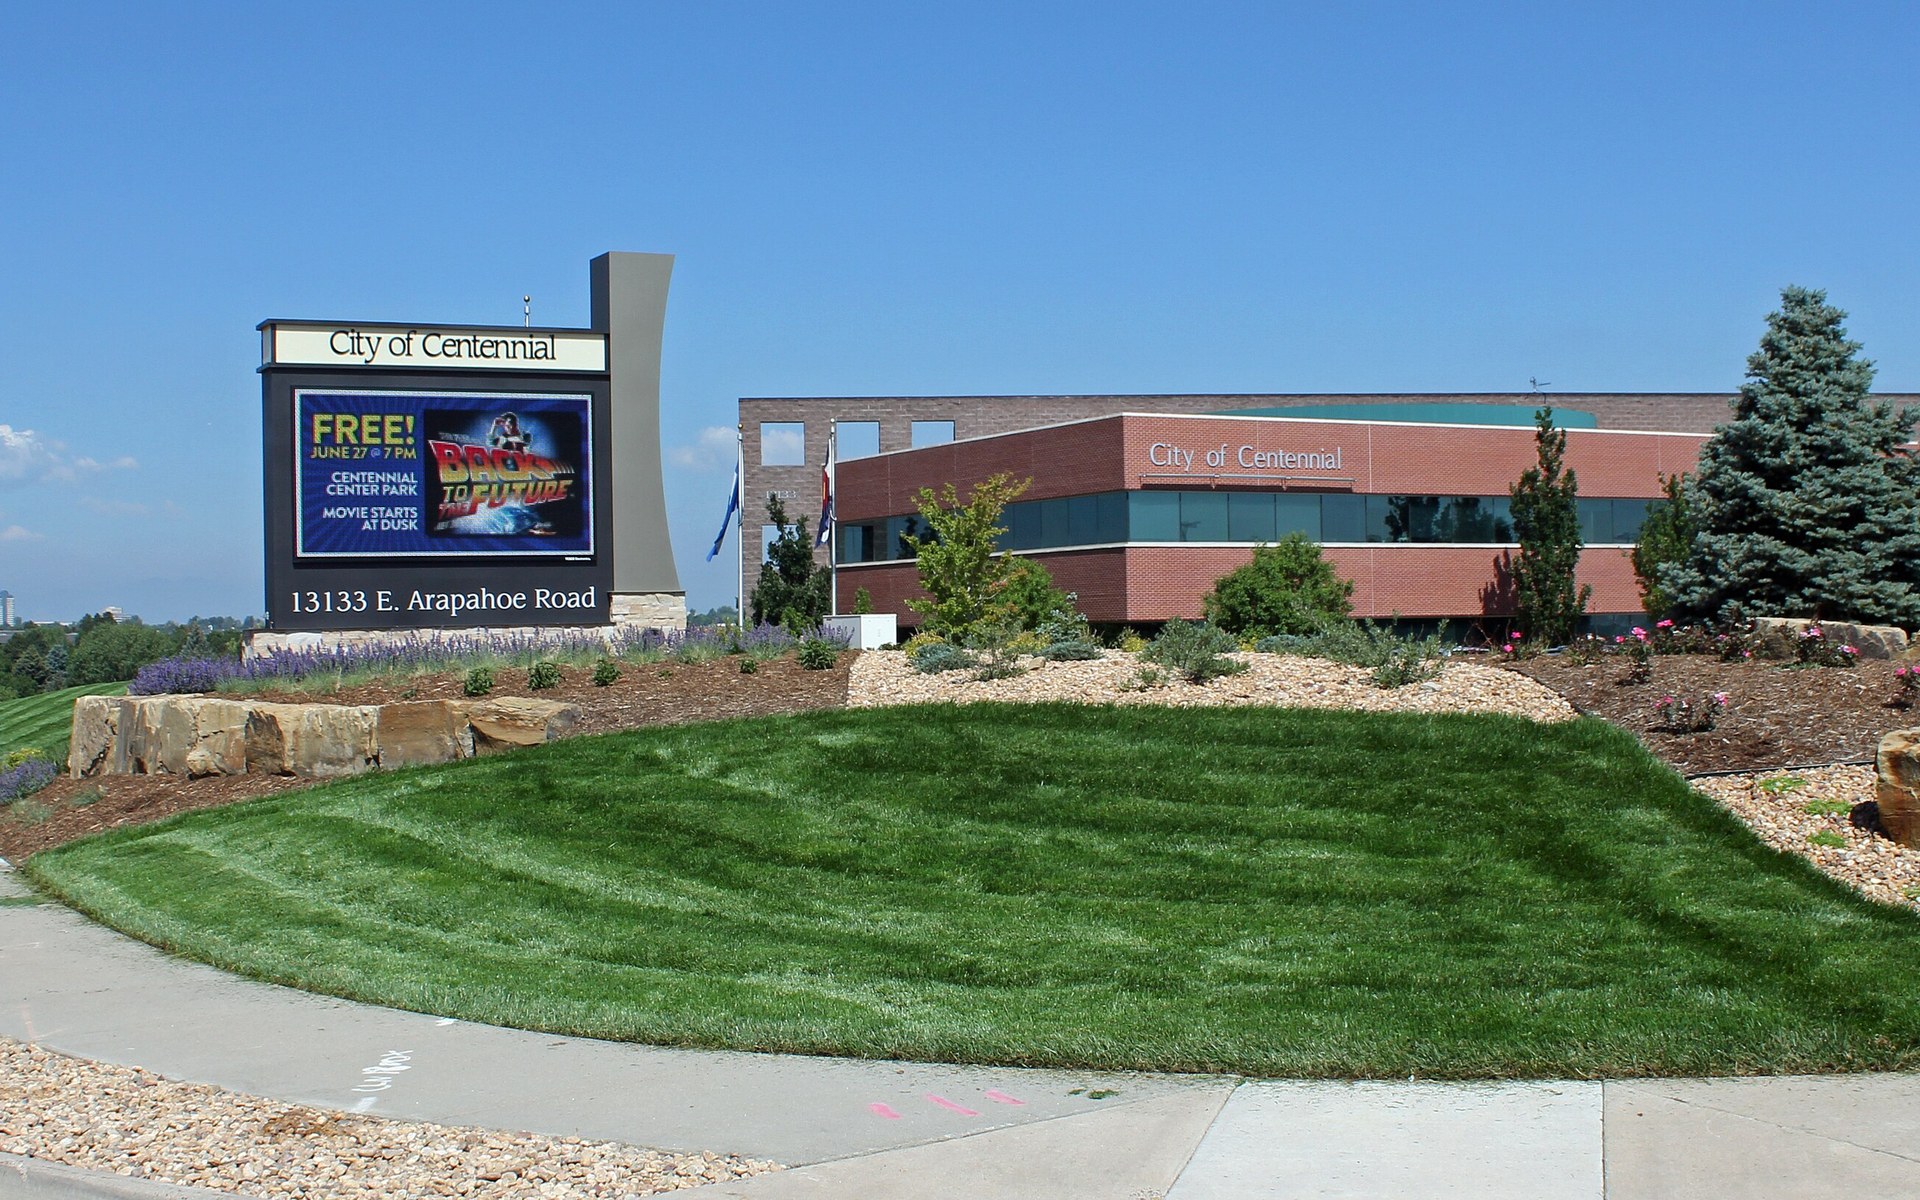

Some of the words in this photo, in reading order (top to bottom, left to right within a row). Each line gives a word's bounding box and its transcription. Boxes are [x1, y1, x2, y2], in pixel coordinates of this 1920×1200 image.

[330, 328, 382, 363] City
[388, 330, 416, 357] of
[422, 333, 556, 360] Centennial
[312, 414, 415, 445] FREE!
[311, 446, 350, 459] JUNE
[352, 447, 369, 459] 27
[370, 447, 381, 458] @
[383, 447, 392, 459] 7
[395, 447, 417, 459] PM
[429, 440, 572, 483] BACK
[1149, 442, 1194, 472] City
[1206, 443, 1228, 468] of
[1238, 445, 1342, 470] Centennial
[331, 471, 418, 483] CENTENNIAL
[326, 484, 380, 496] CENTER
[382, 484, 418, 496] PARK
[442, 485, 468, 503] TO
[468, 480, 573, 515] FUTURE
[322, 507, 369, 519] MOVIE
[370, 507, 418, 519] STARTS
[361, 519, 379, 531] AT
[381, 519, 419, 531] DUSK
[292, 590, 367, 613] 13133
[376, 591, 400, 612] E.
[407, 587, 527, 617] Arapahoe
[534, 586, 597, 609] Road
